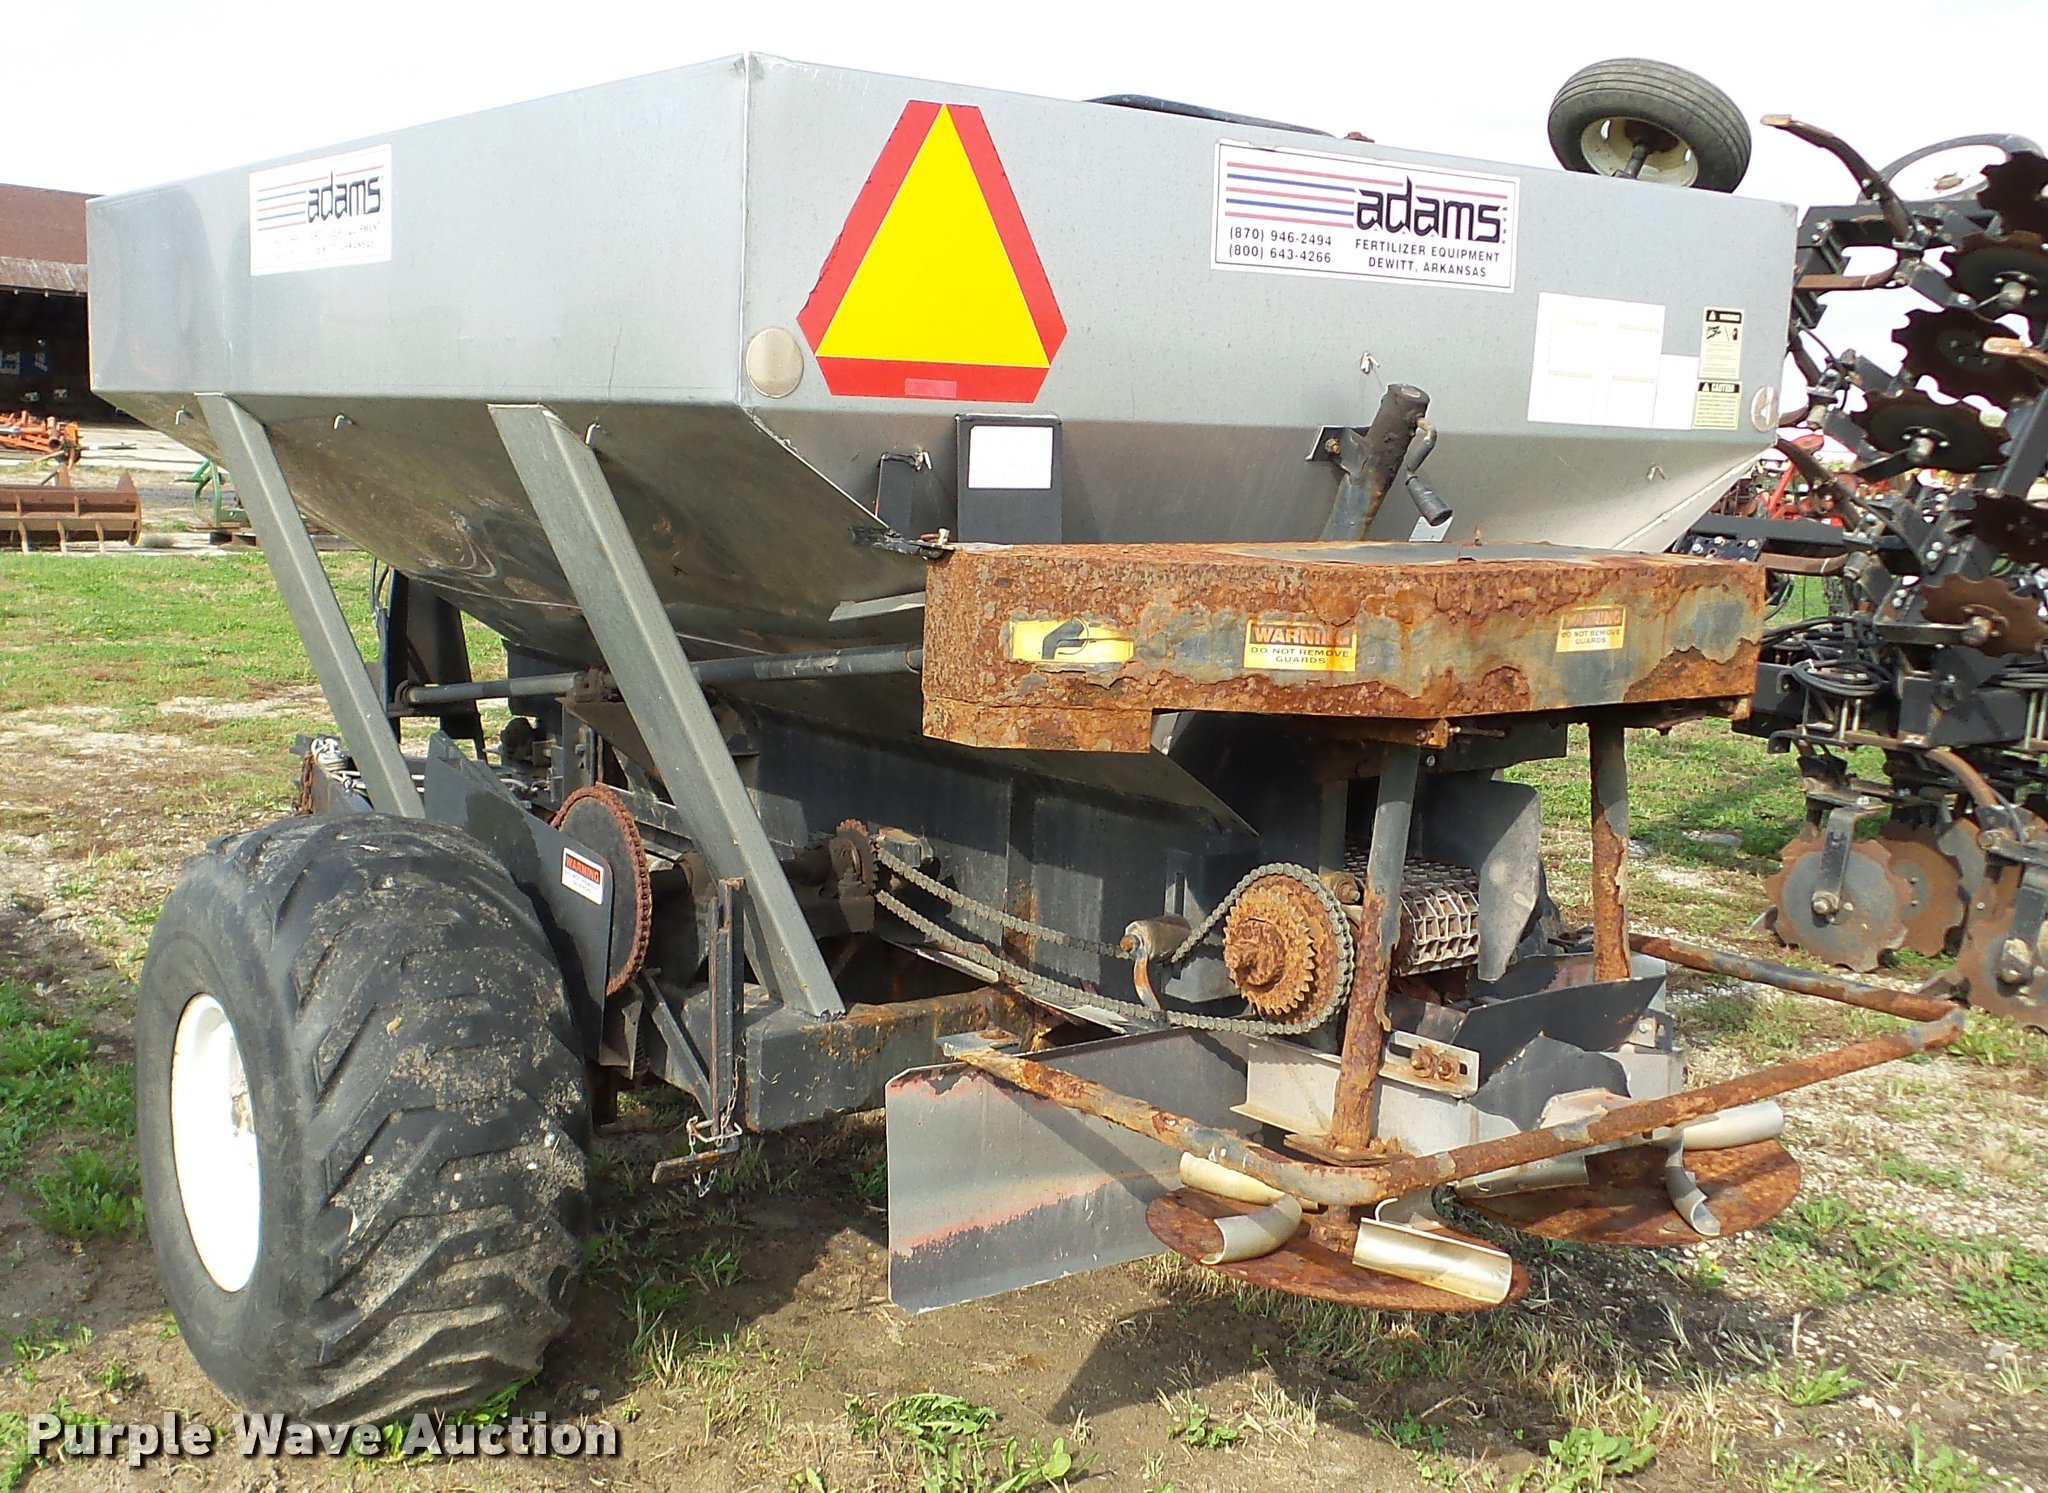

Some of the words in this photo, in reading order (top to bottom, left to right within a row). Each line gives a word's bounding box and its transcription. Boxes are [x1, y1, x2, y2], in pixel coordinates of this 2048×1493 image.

[307, 170, 381, 223] adams
[1356, 175, 1501, 244] adams
[1230, 226, 1264, 242] (870)
[1270, 229, 1332, 246] 946-2494
[1229, 243, 1263, 260] (800)
[1270, 247, 1331, 263] 643-4266
[1355, 238, 1426, 255] FERTILIZER
[1431, 246, 1500, 262] EQUIPMENT
[1368, 256, 1418, 273] DEWITT,
[1423, 262, 1486, 277] ARKANSAS
[1253, 626, 1351, 646] WARNIG
[1251, 646, 1268, 654] DO
[1272, 646, 1296, 655] NOT
[1299, 648, 1349, 658] REMOVE
[1275, 656, 1326, 665] GUARDS
